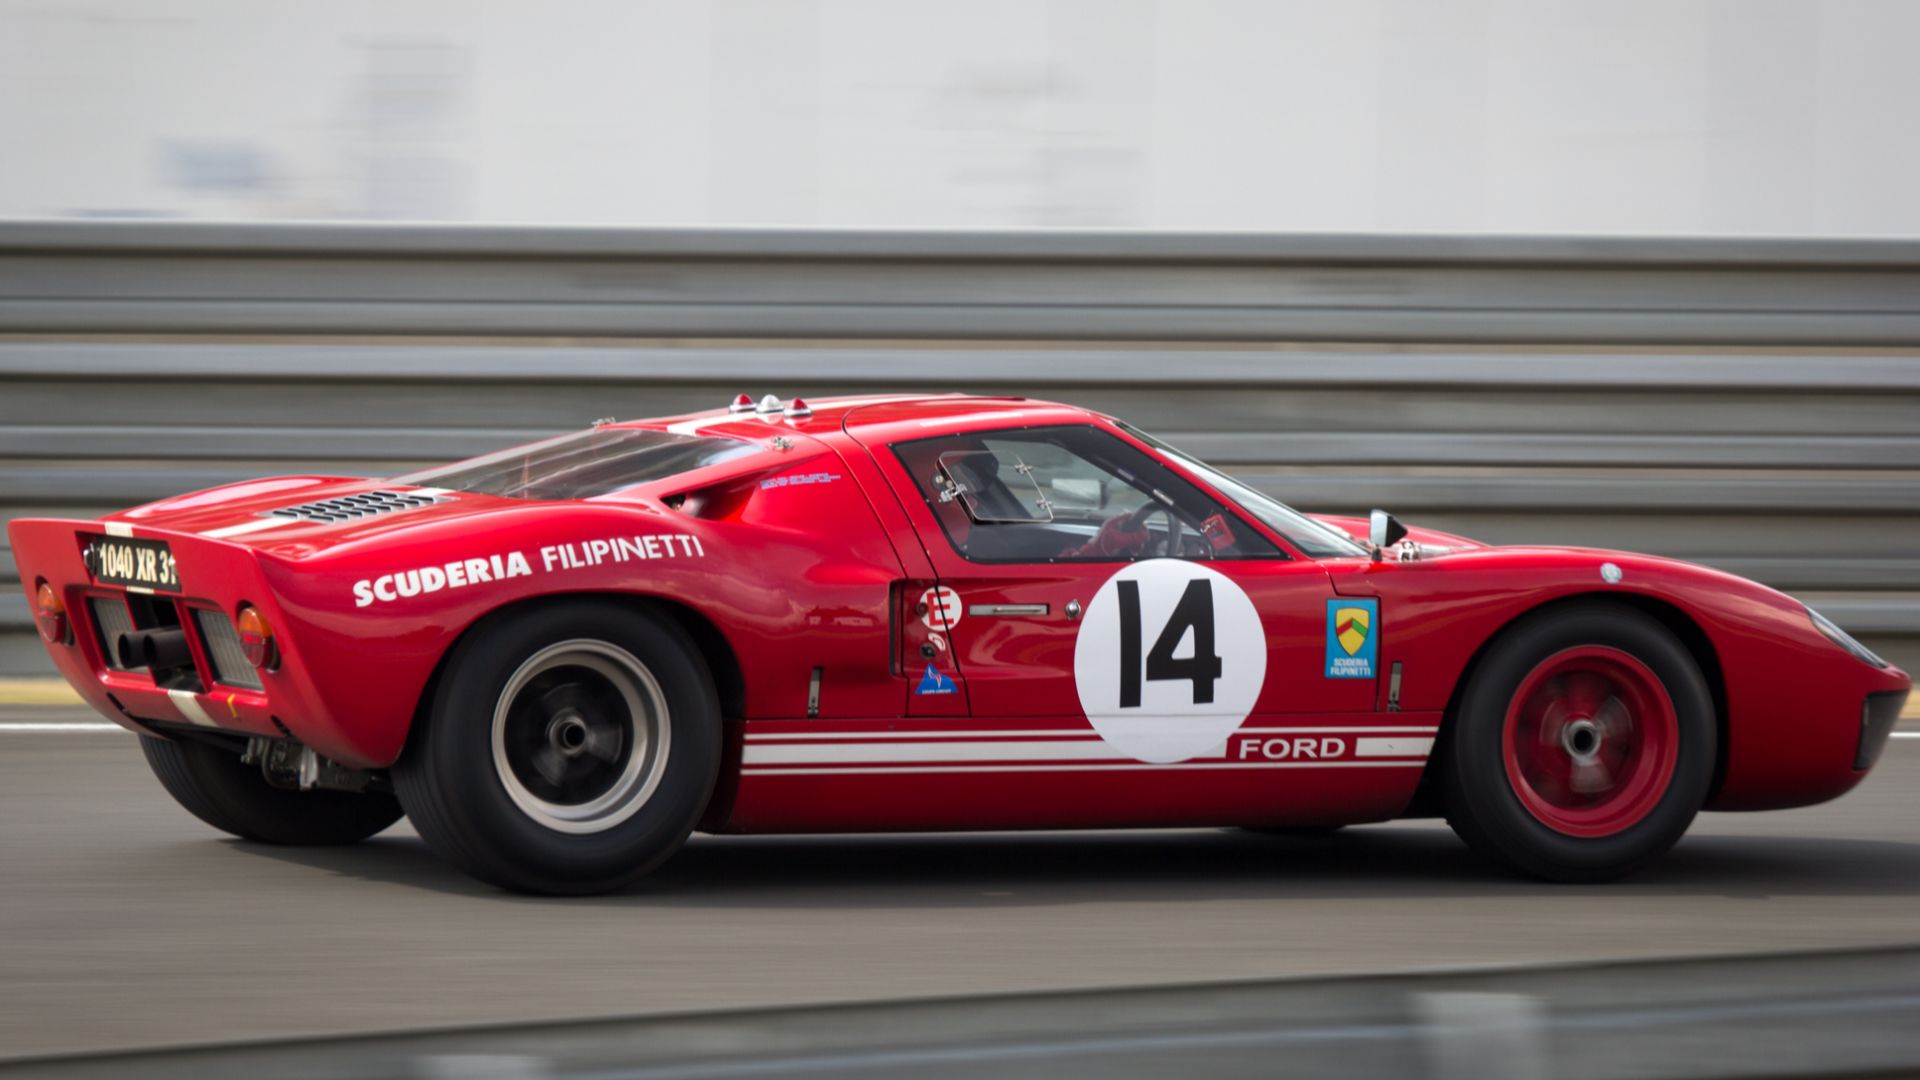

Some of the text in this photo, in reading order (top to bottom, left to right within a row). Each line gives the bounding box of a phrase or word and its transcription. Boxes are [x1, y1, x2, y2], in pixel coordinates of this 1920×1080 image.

[100, 543, 134, 579] 1040
[136, 547, 157, 582] XR
[353, 534, 705, 608] SCUDERIA FILIPINETTI
[926, 591, 954, 626] E
[1117, 578, 1222, 708] 14
[1330, 666, 1371, 676] FILIPINETTI
[1333, 657, 1369, 667] SCUDERIA
[1239, 737, 1346, 760] FORD
